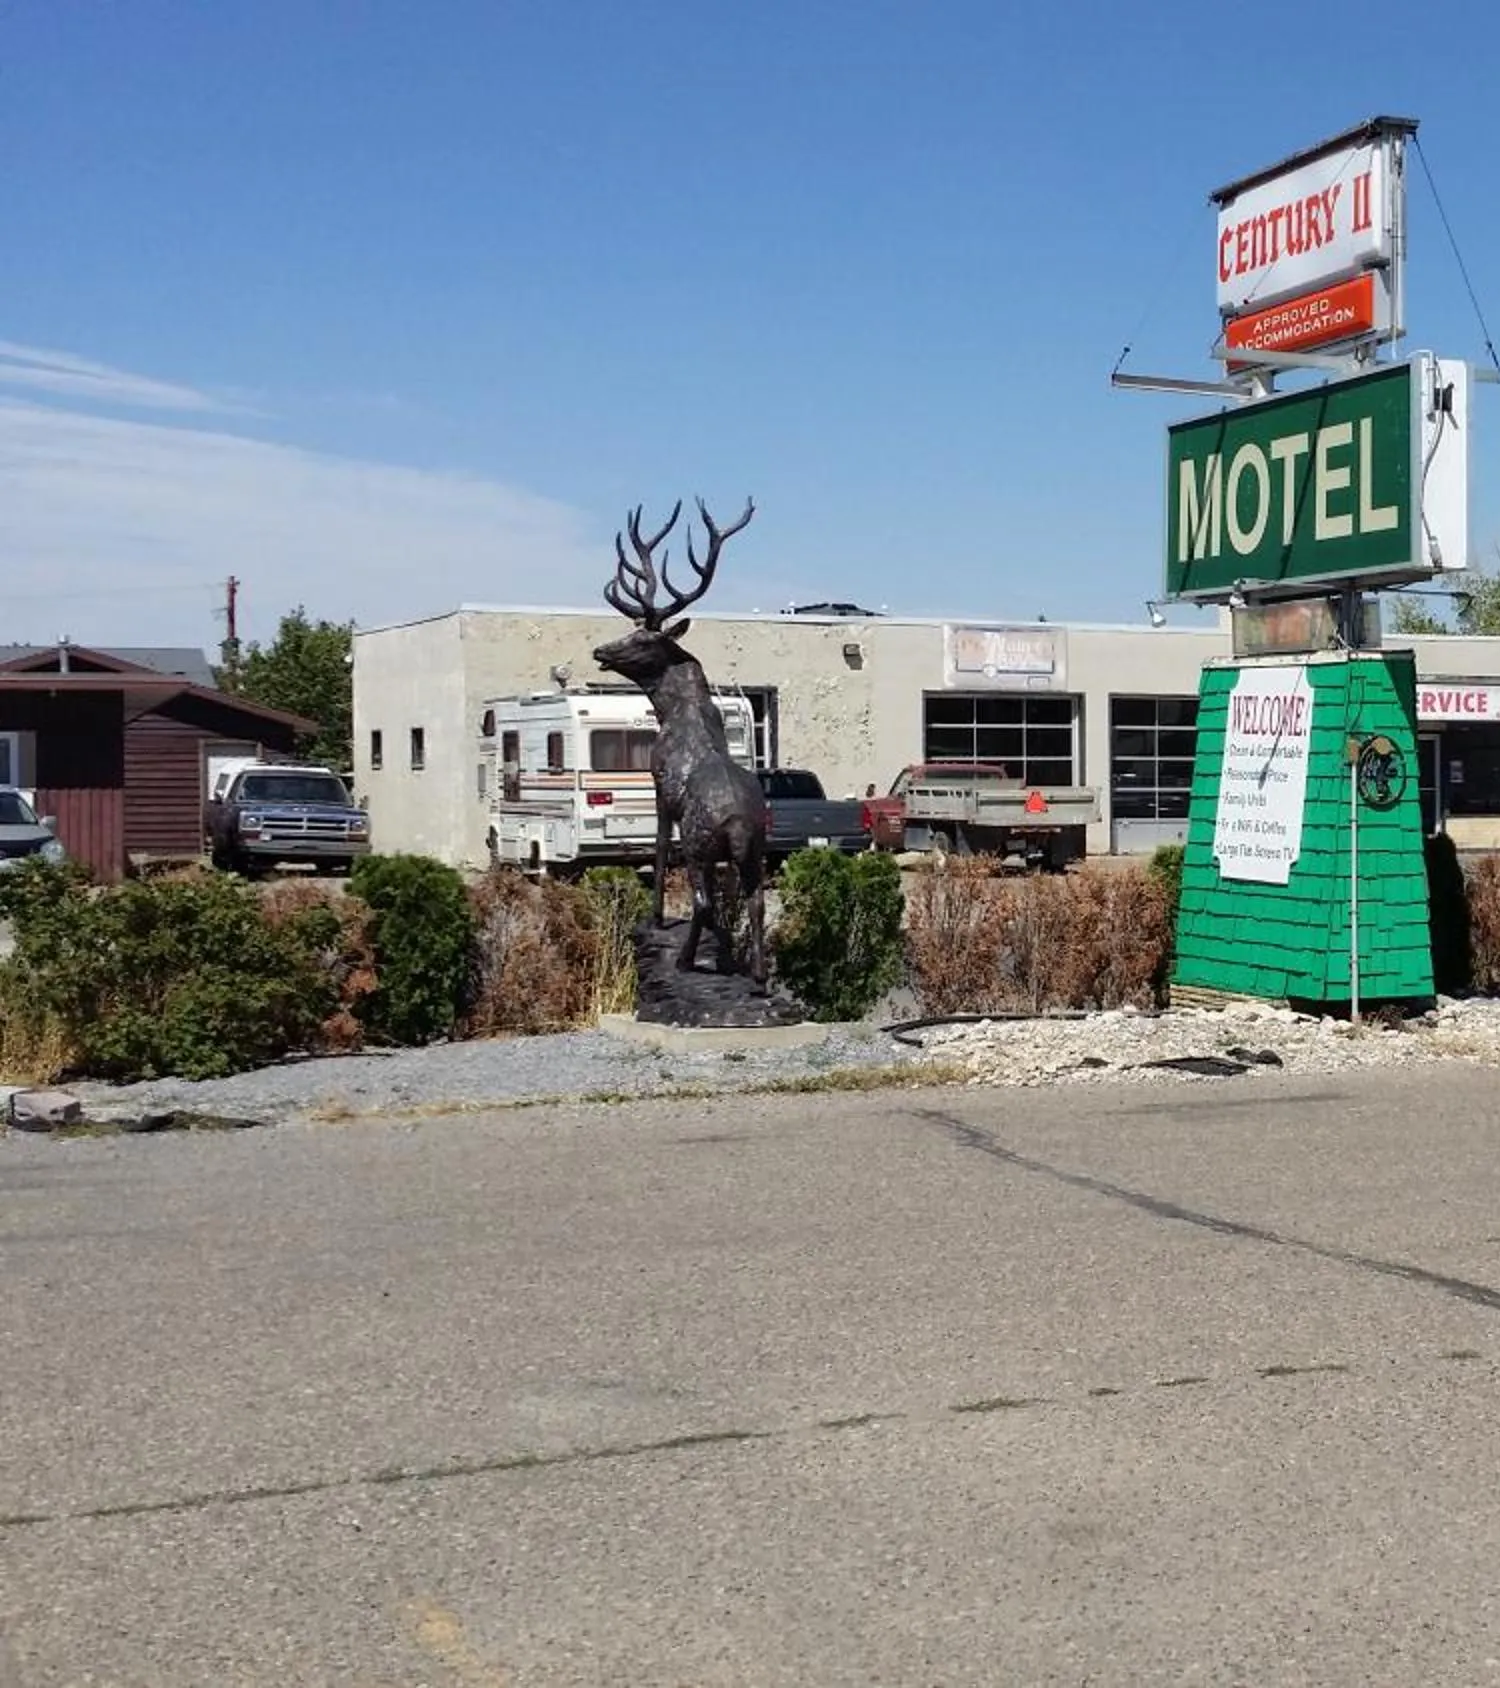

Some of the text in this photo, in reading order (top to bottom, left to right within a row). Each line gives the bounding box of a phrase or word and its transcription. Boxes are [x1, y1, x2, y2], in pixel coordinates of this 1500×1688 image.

[1219, 172, 1372, 282] CENTURY II
[1235, 307, 1355, 350] ACCOMMODATION
[1253, 299, 1330, 334] APPROVED
[1178, 416, 1399, 562] MOTEL
[1257, 744, 1303, 759] Comortable
